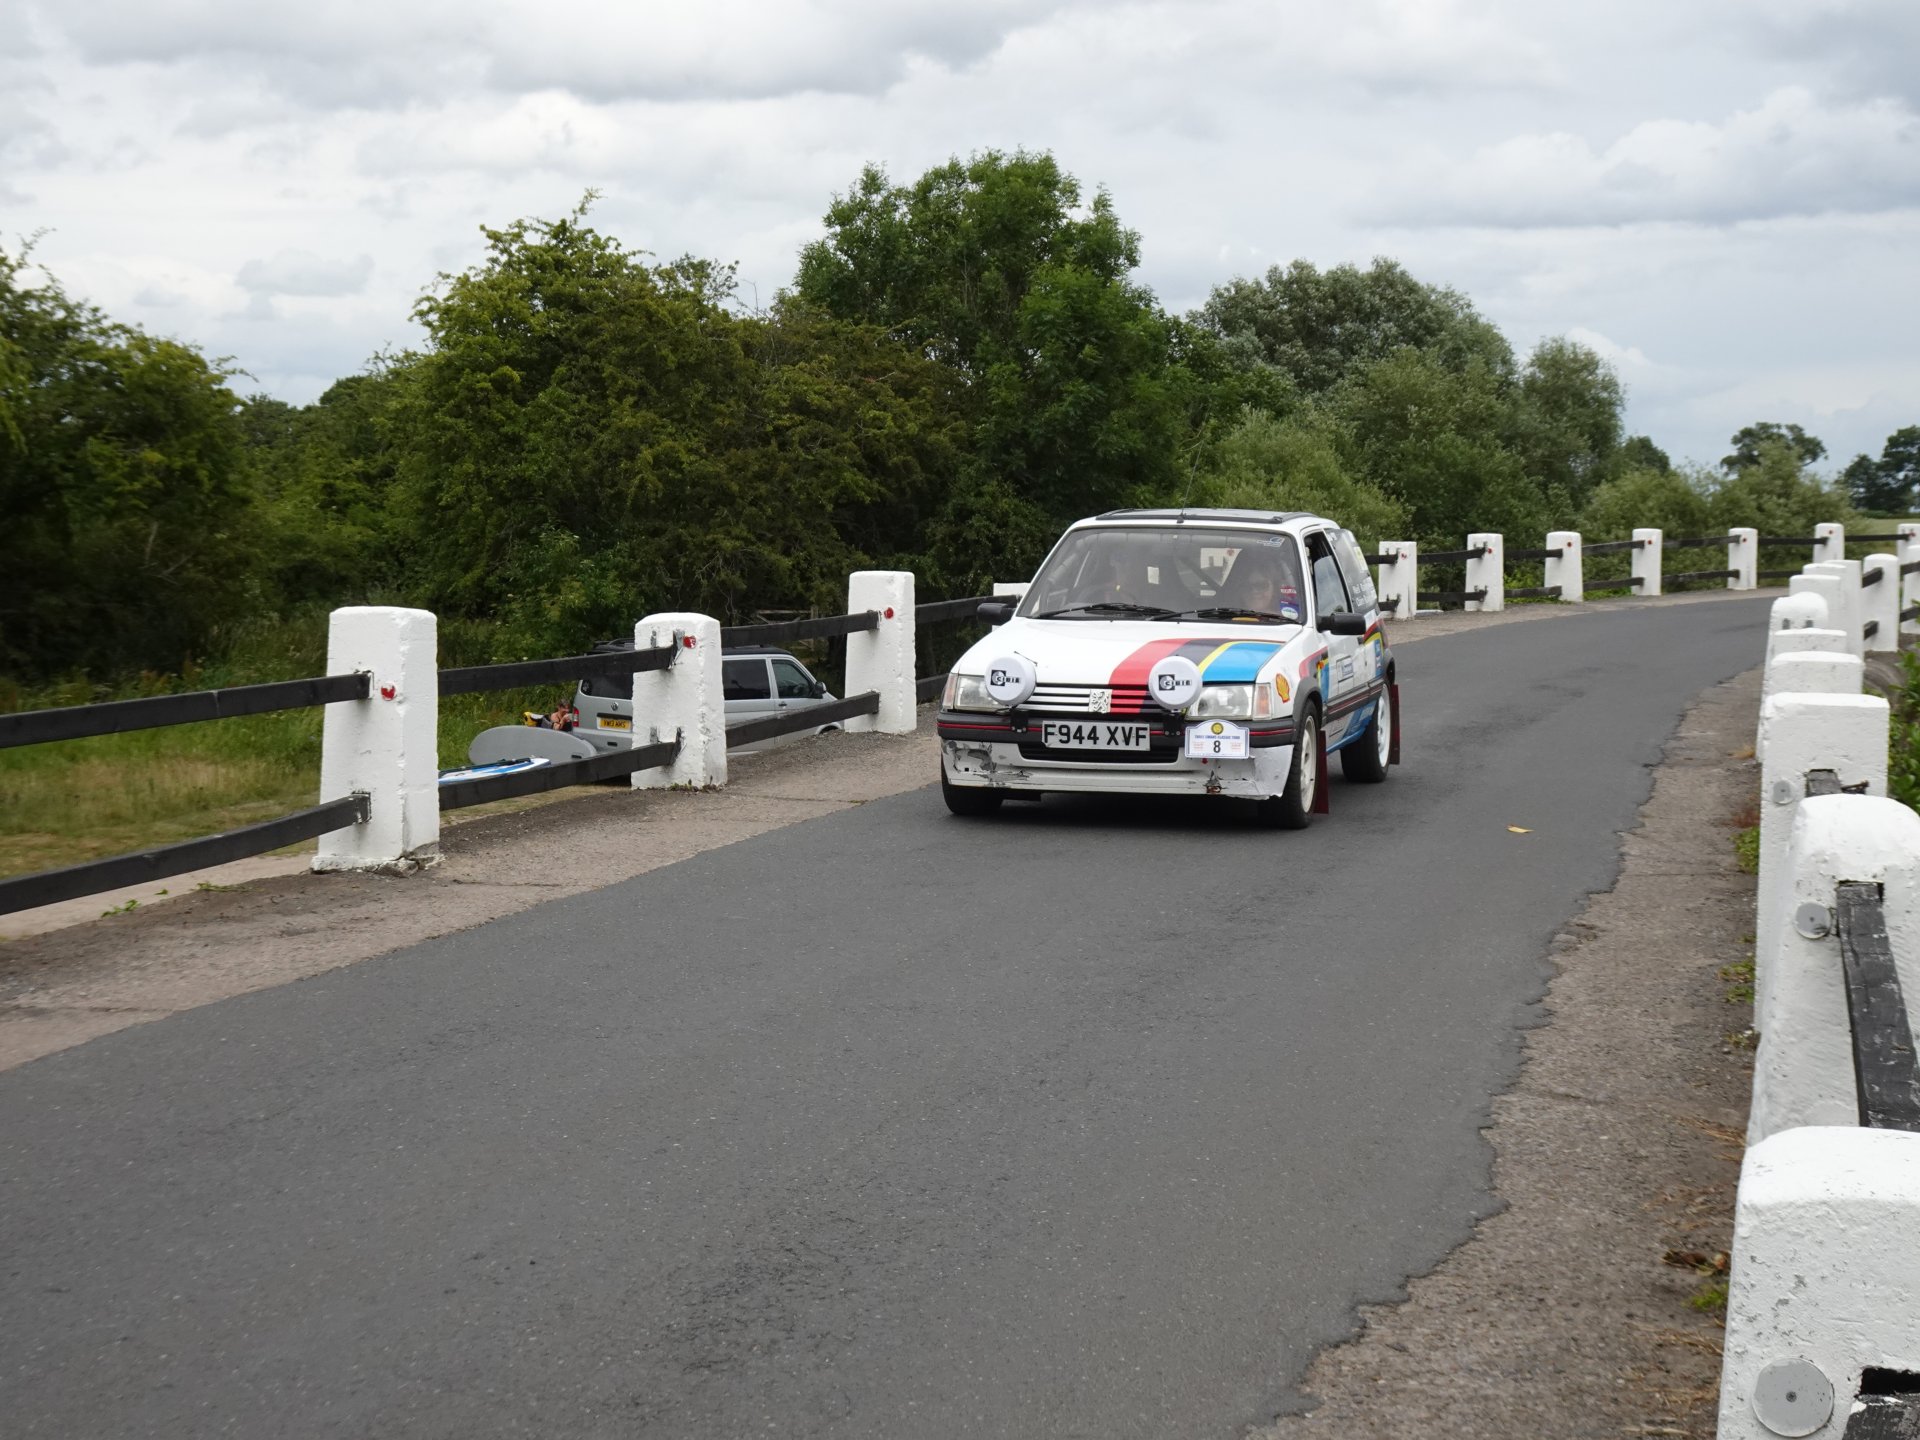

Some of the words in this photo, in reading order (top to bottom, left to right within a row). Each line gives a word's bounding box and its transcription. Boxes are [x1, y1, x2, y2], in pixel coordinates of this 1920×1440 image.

[1044, 724, 1099, 745] F944
[1106, 726, 1148, 747] XVF
[1213, 740, 1221, 753] 8
